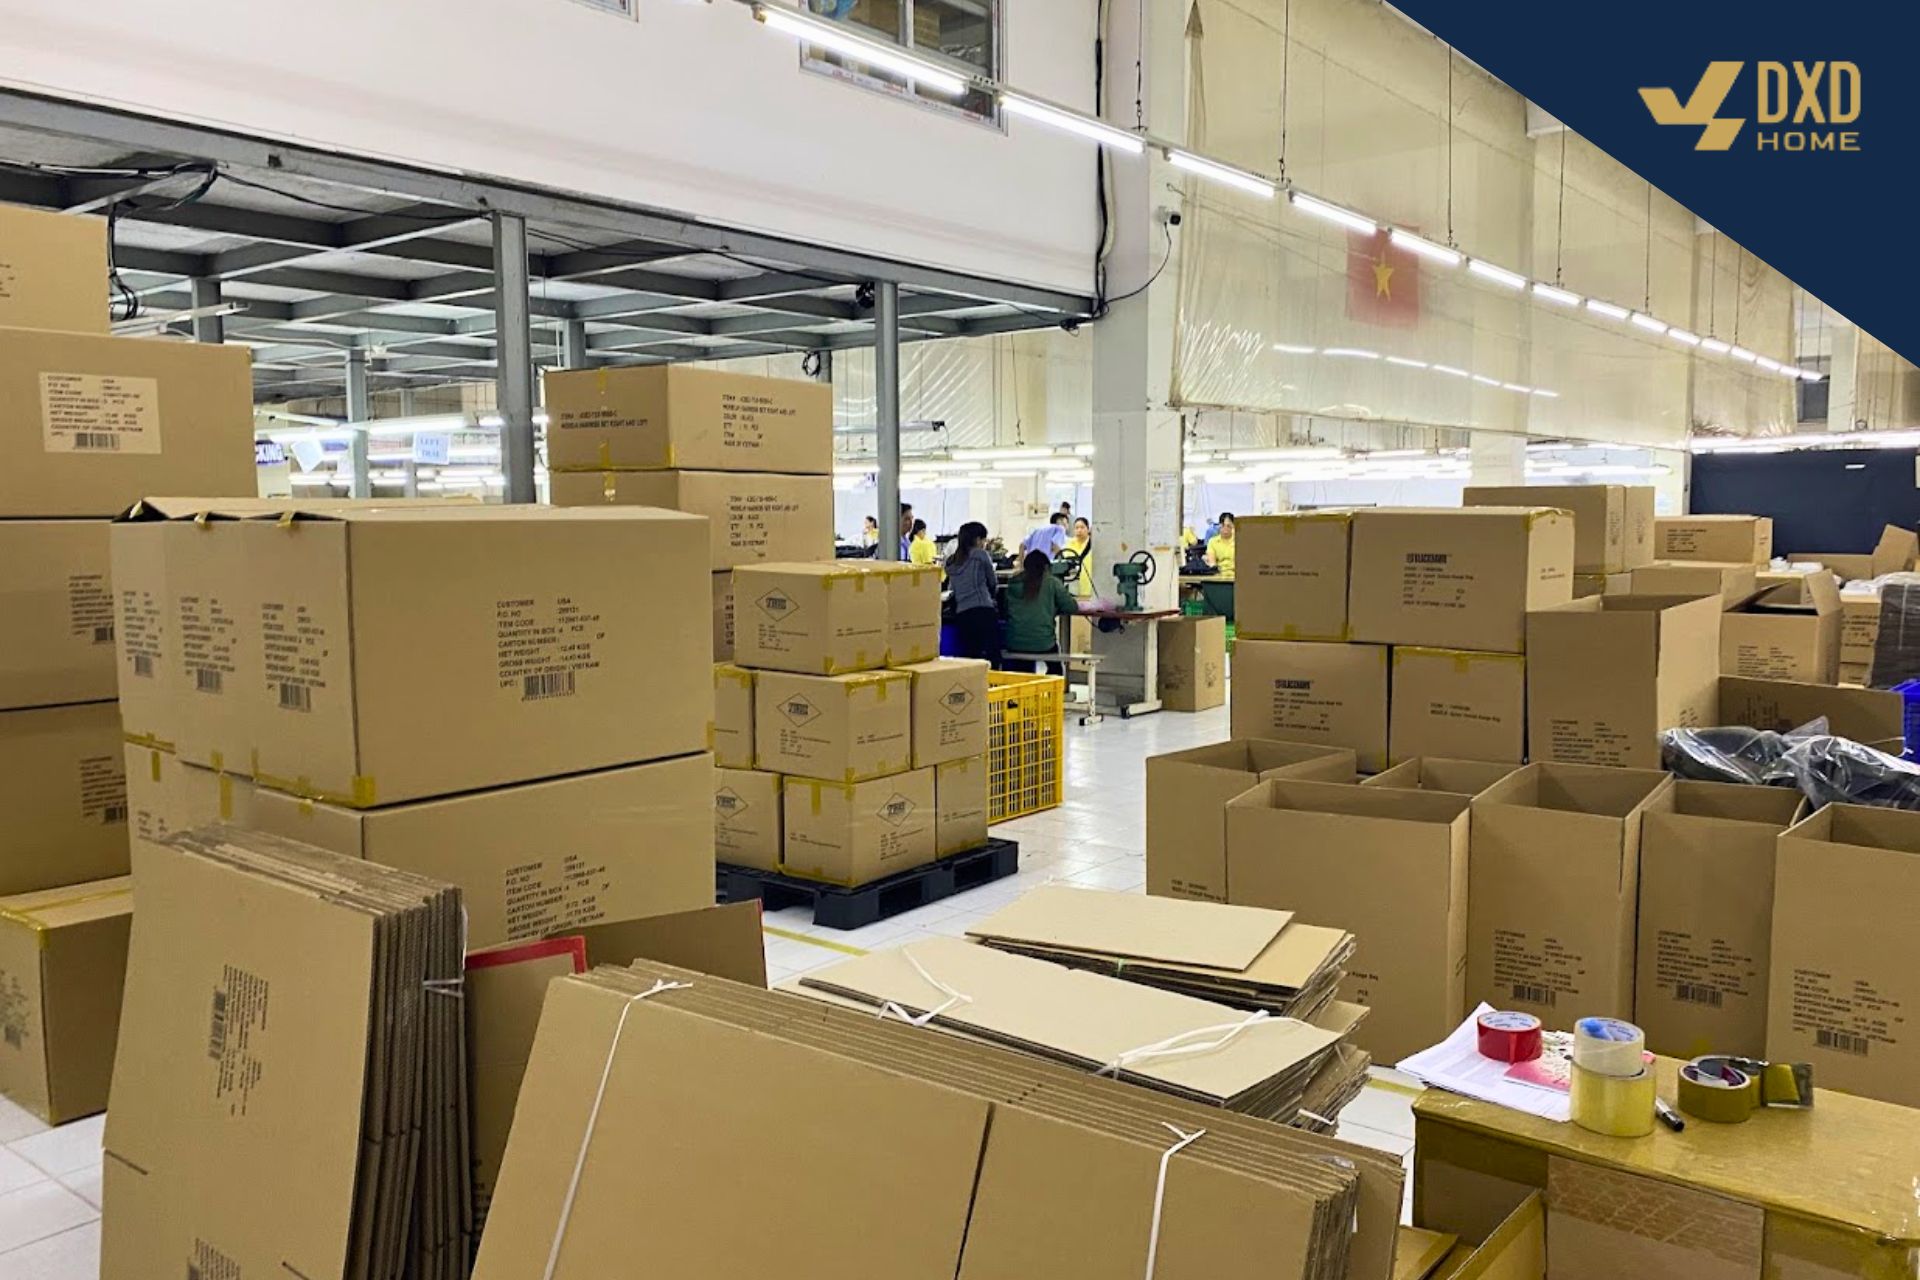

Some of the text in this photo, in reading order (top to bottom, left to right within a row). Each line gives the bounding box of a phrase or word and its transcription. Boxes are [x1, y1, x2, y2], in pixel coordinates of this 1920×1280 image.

[497, 599, 534, 609] CUSTOMER
[514, 619, 534, 627] CODE
[498, 628, 531, 638] QUANTITY
[541, 627, 555, 635] BOX
[498, 639, 527, 648] CARTON
[528, 636, 556, 645] NUMBER
[498, 650, 512, 658] NET
[513, 648, 540, 657] WEIGHT
[499, 658, 523, 668] GROSS
[524, 656, 551, 665] WEIGHT
[500, 668, 532, 678] COUNTRY
[506, 862, 542, 876] CUSTOMER
[506, 892, 539, 906] QUANTITY
